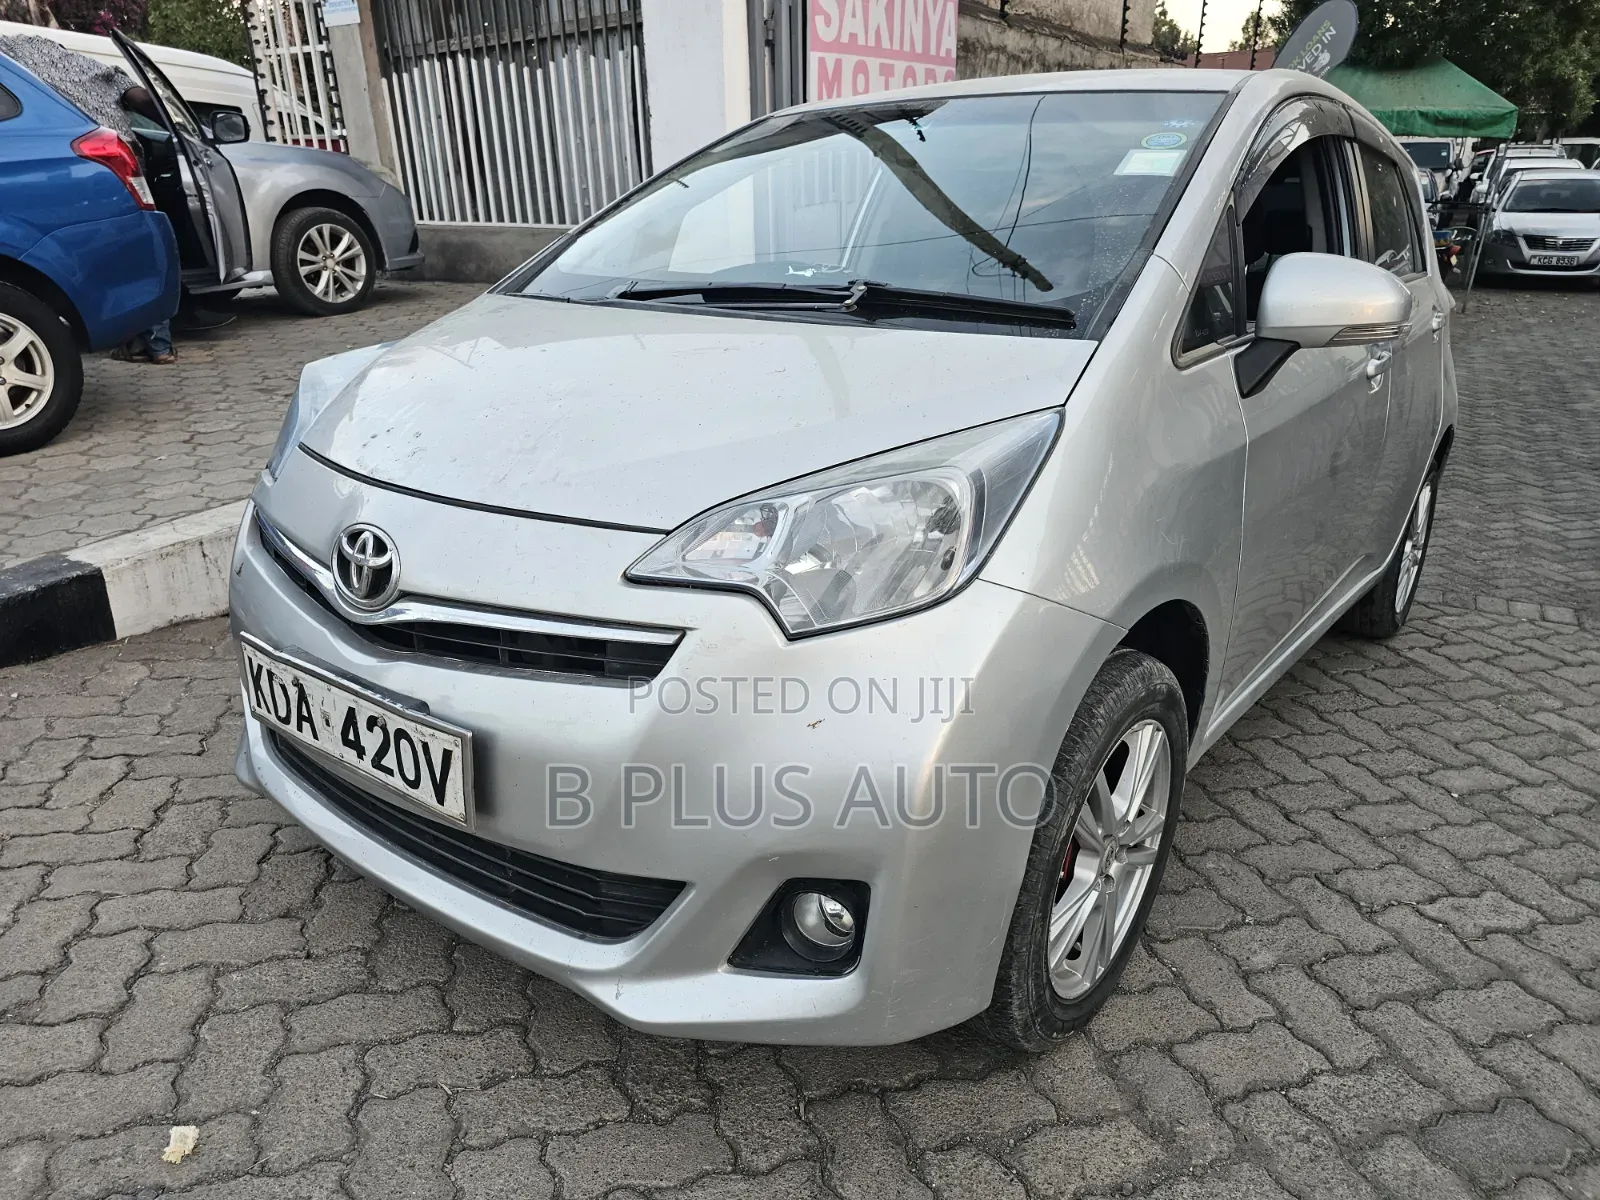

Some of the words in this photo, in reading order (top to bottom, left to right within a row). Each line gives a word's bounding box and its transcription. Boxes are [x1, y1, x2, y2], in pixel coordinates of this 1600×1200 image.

[815, 0, 956, 59] SAKINYA
[1300, 20, 1331, 56] LOANS
[1321, 26, 1336, 44] IN
[247, 655, 319, 742] KDA
[340, 706, 453, 807] 420V
